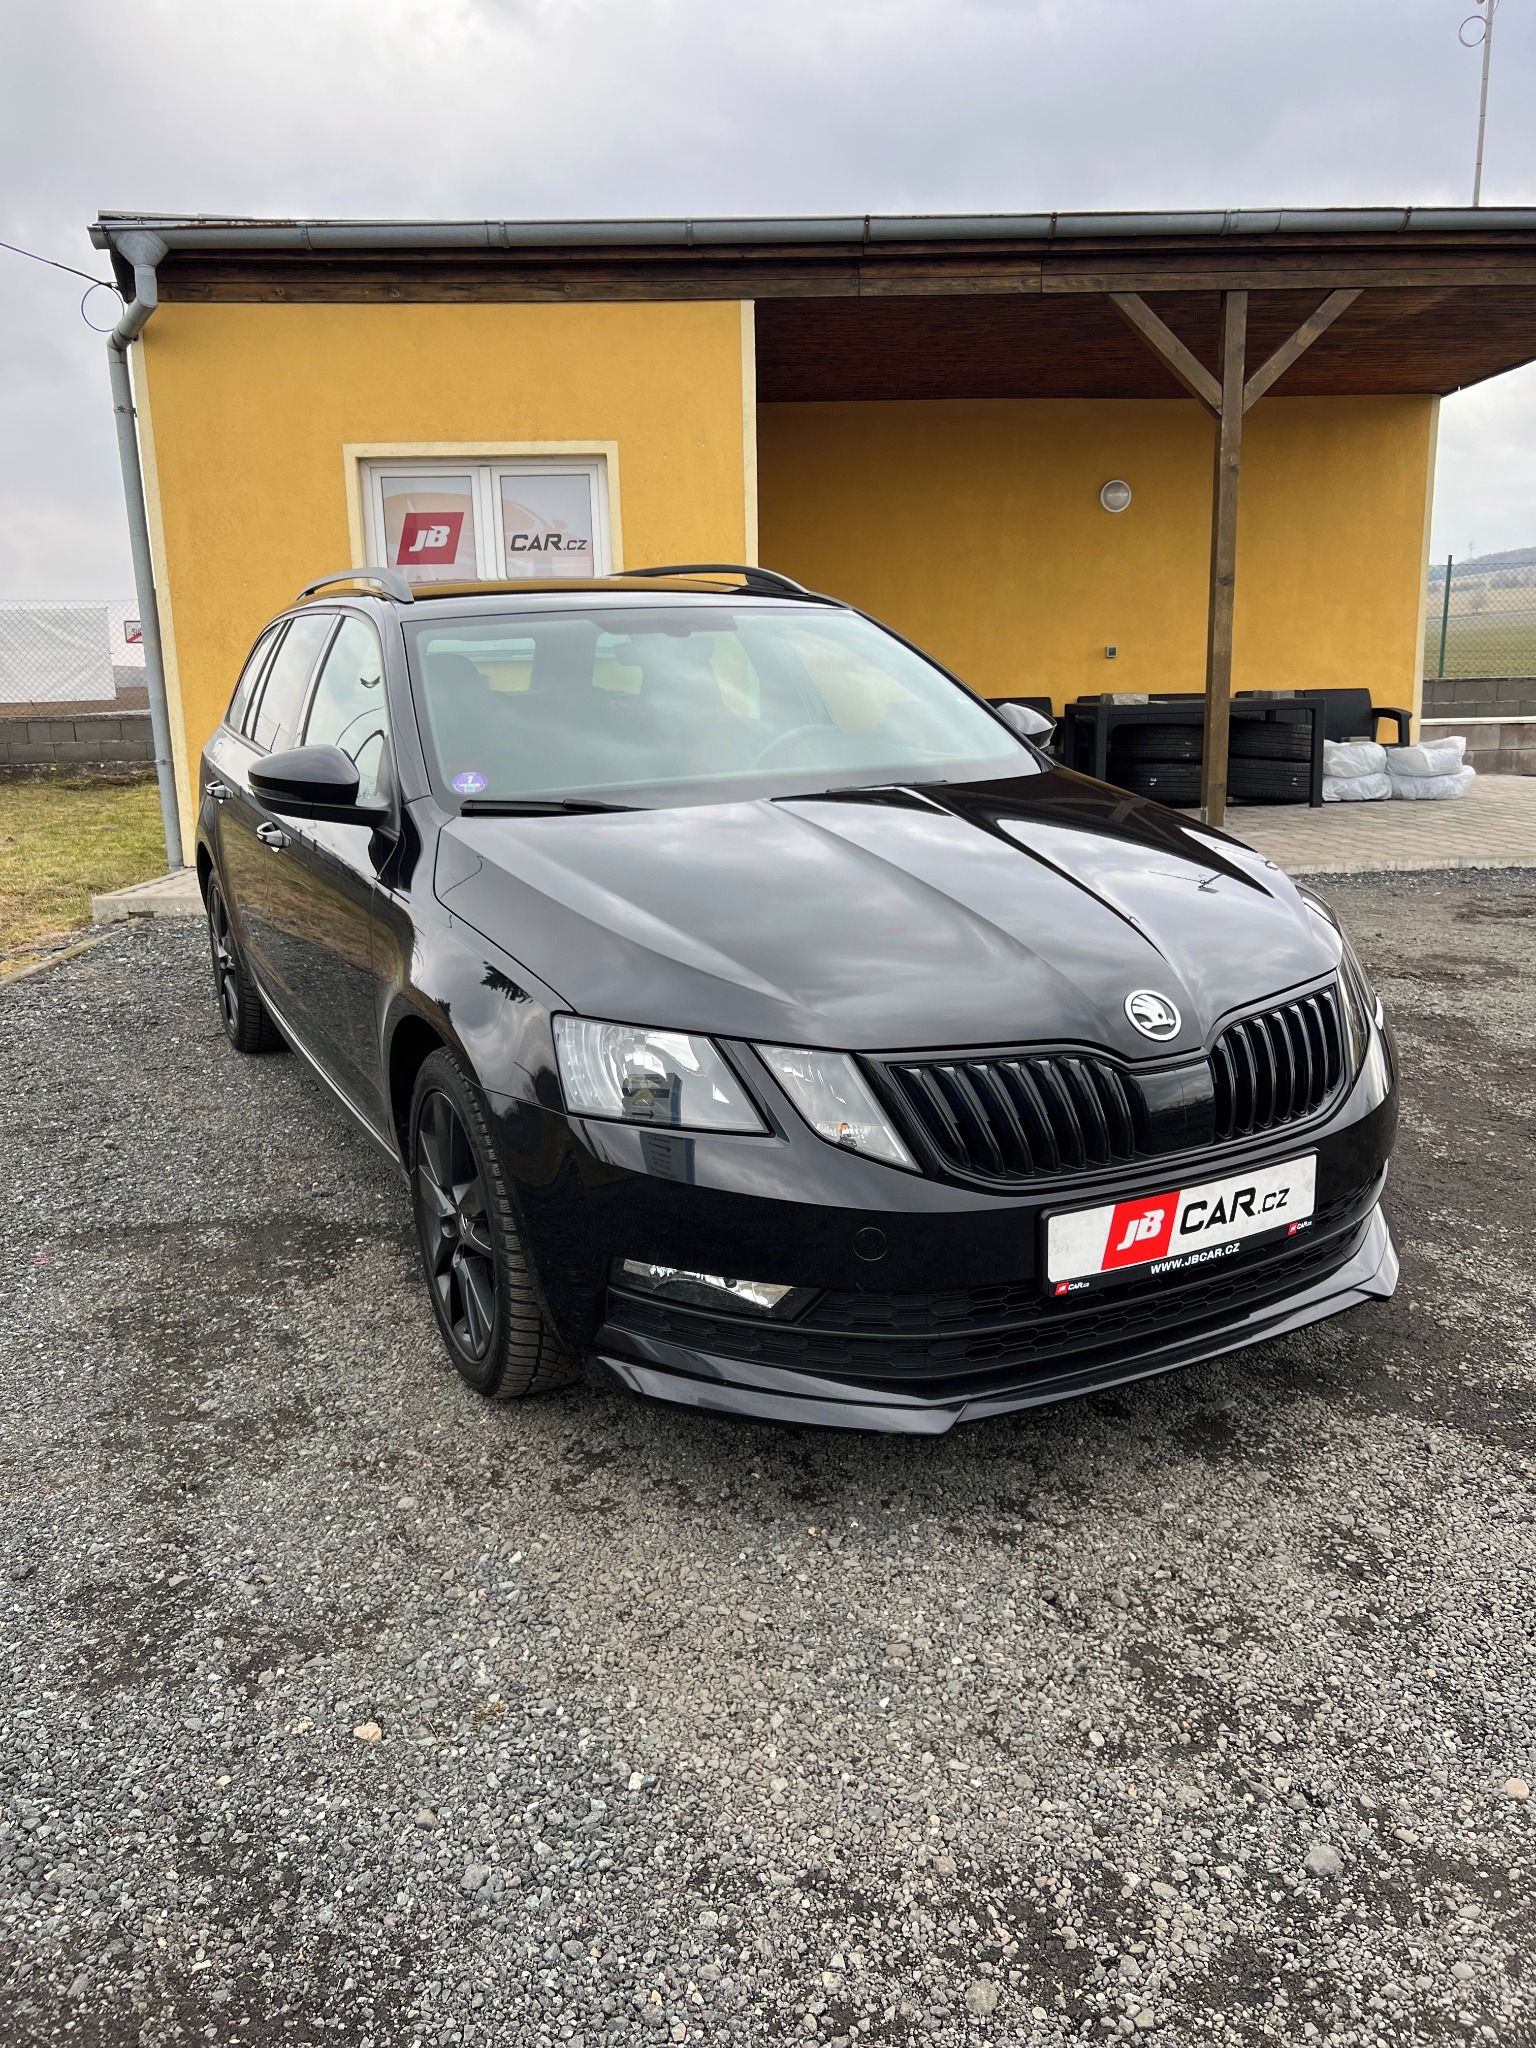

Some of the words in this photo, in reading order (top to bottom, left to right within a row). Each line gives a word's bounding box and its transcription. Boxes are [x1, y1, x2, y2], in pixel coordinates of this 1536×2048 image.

[409, 525, 450, 552] JB
[1116, 1208, 1165, 1251] JB
[1150, 1242, 1241, 1275] WWW.JBCAR.CZ
